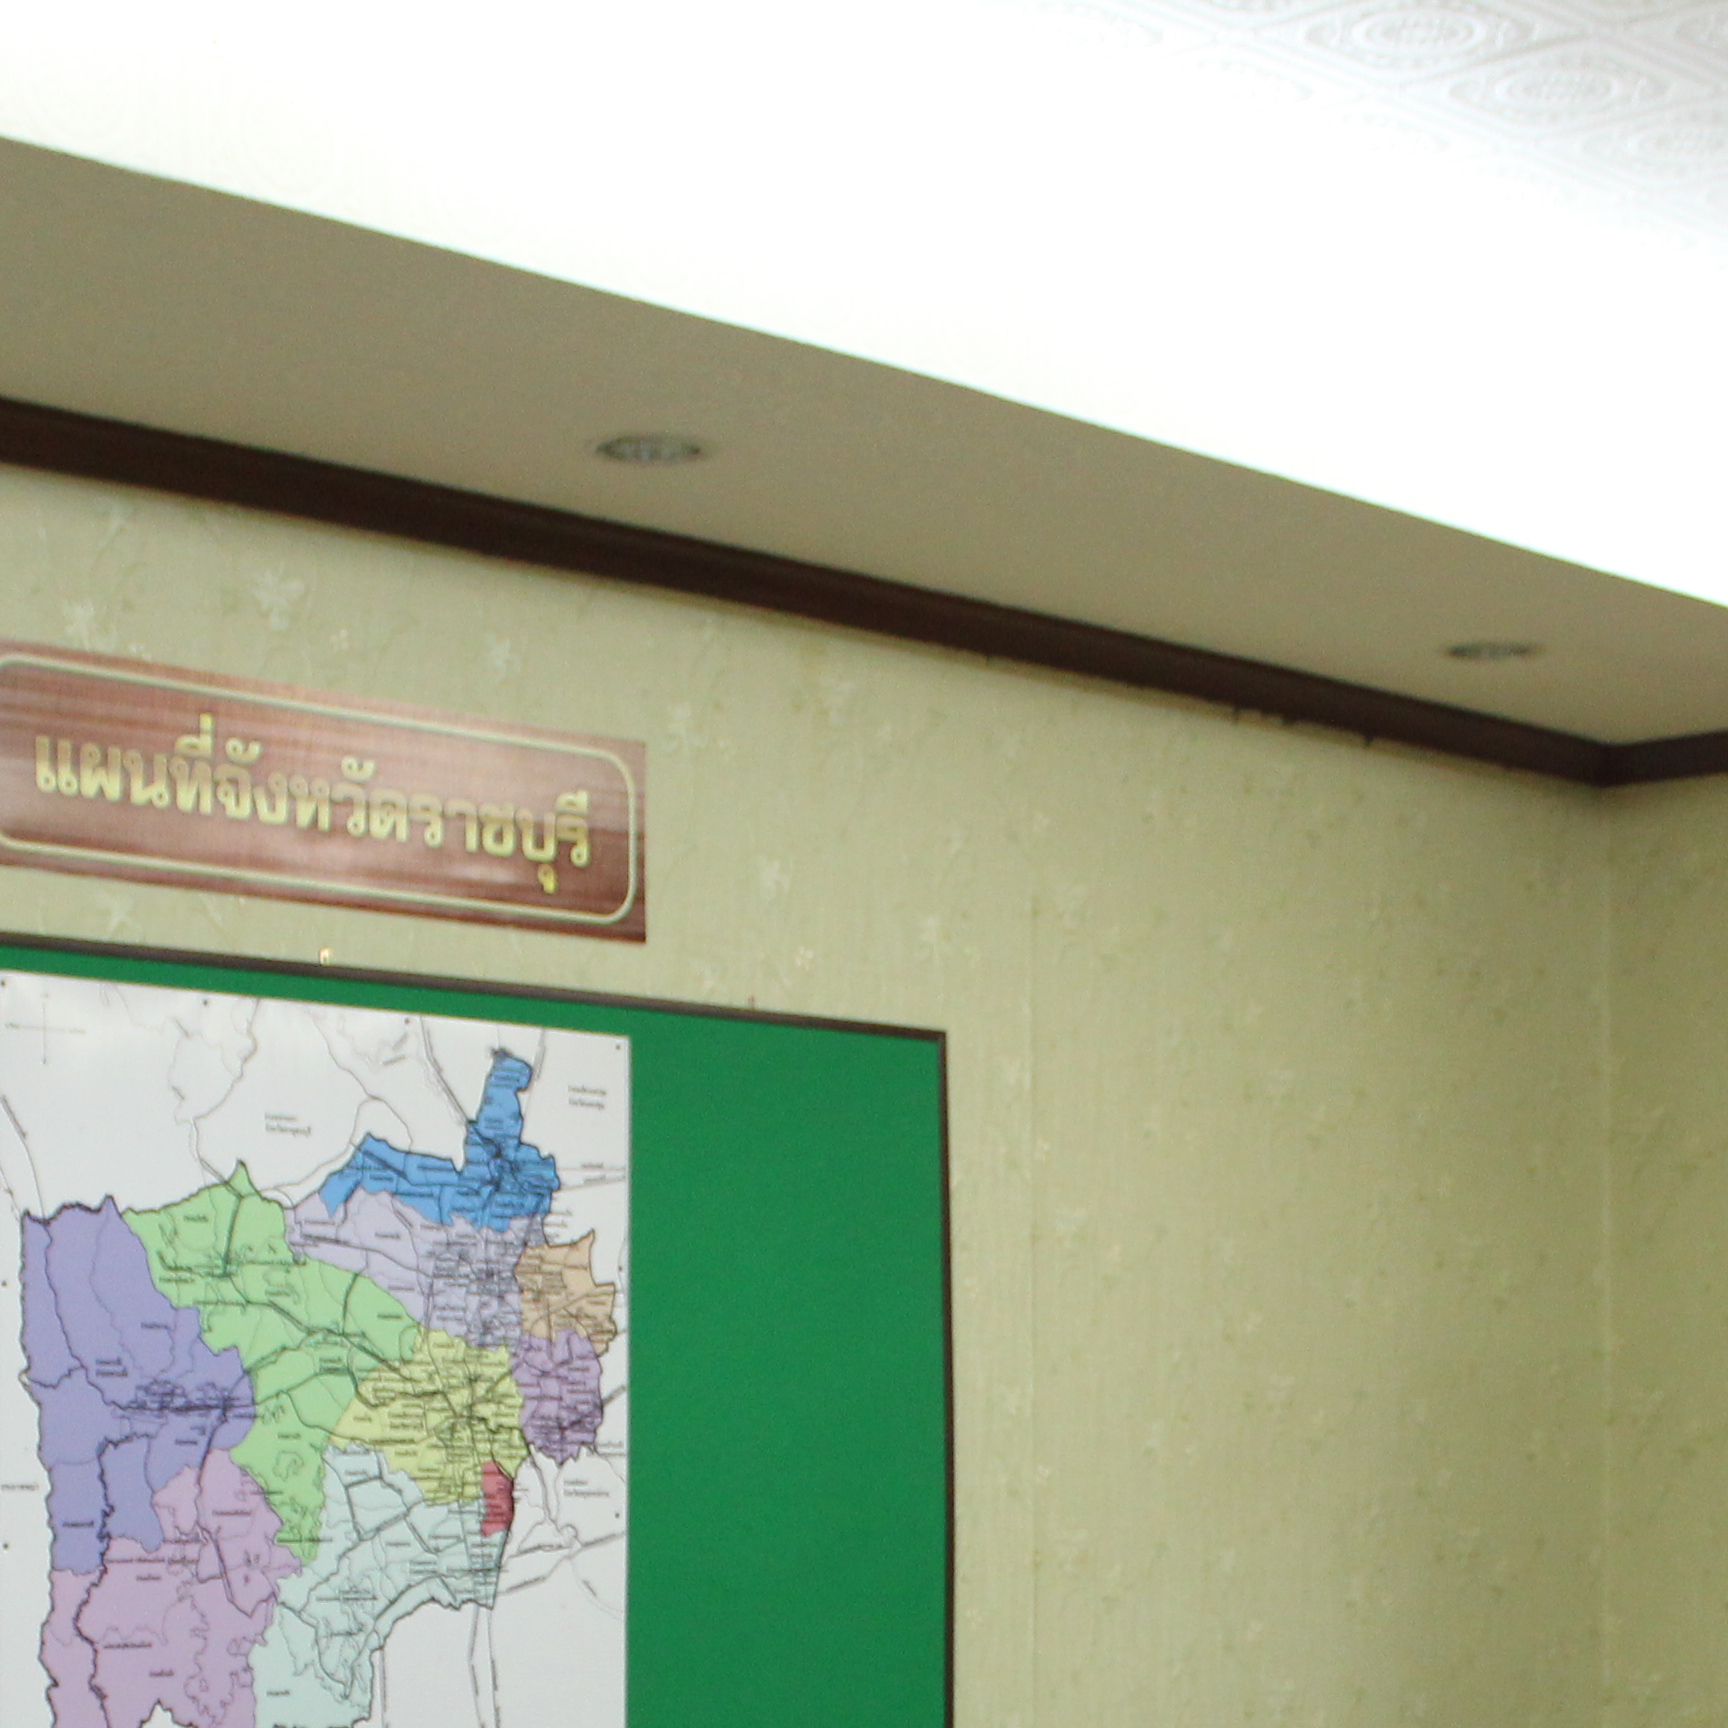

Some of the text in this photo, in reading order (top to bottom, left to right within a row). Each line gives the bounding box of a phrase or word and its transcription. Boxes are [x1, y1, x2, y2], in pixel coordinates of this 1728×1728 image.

[34, 713, 591, 893] แผนที่จังหวัดราชบุรี
